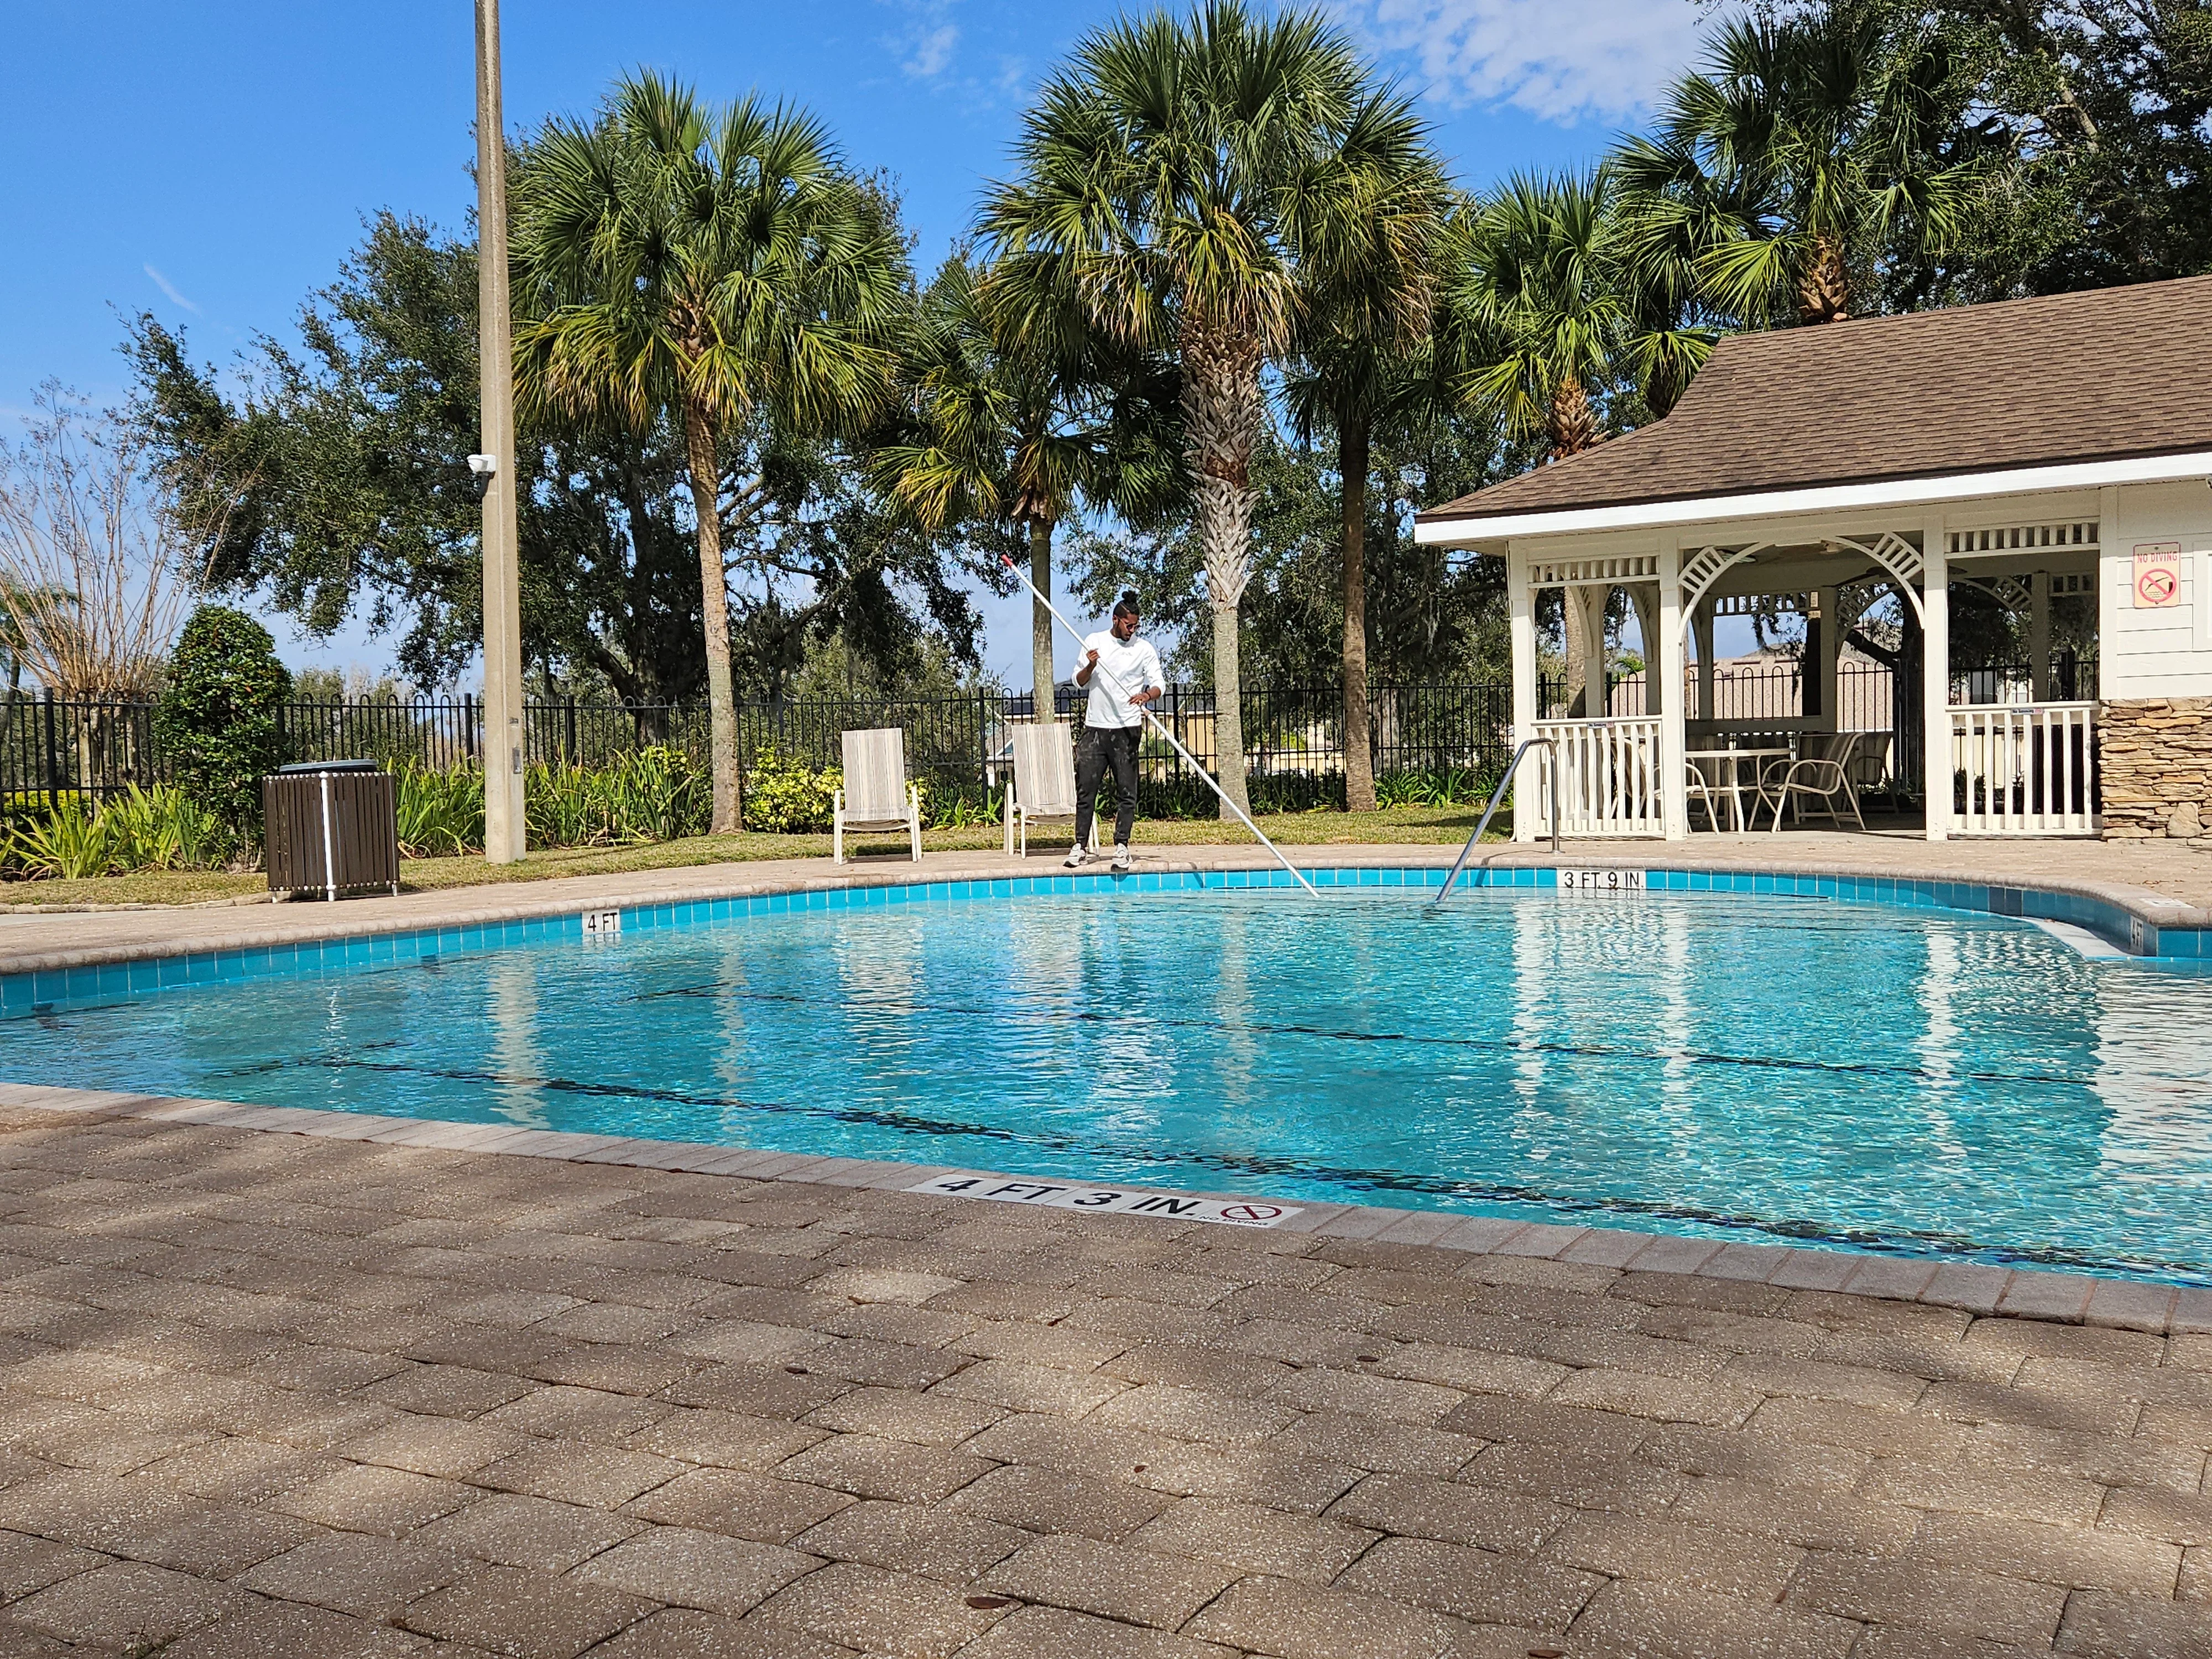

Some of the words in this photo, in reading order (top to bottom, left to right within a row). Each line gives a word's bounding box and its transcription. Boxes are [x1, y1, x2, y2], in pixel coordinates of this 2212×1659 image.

[2137, 554, 2148, 563] NO
[2151, 551, 2177, 562] DIVING
[1564, 872, 1574, 888] 3
[1608, 872, 1618, 889] 9
[588, 914, 597, 932] 4
[602, 912, 618, 932] FT
[2132, 920, 2136, 944] 4
[2136, 922, 2142, 948] FT
[935, 1179, 983, 1192] 4
[984, 1183, 1069, 1200] FT
[1073, 1192, 1122, 1206] 3
[1129, 1197, 1202, 1215] IN.
[1222, 1218, 1269, 1226] DIVING
